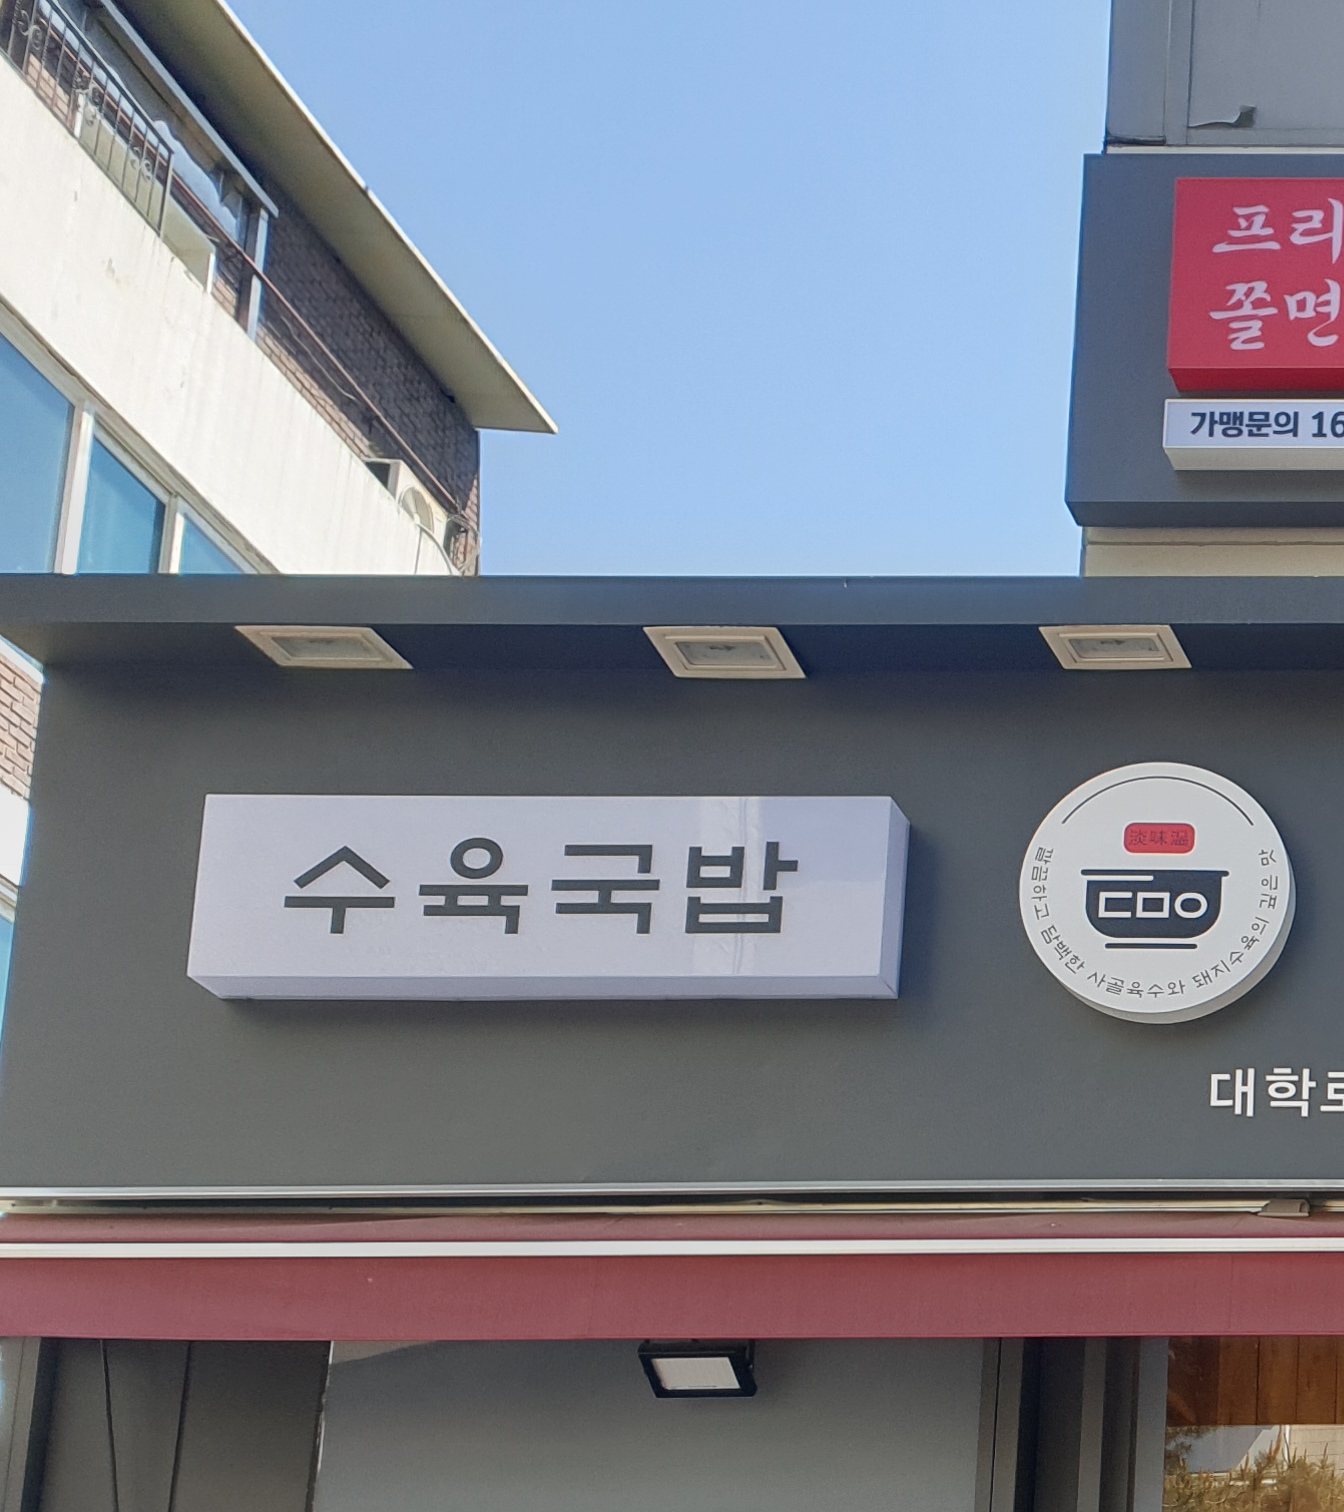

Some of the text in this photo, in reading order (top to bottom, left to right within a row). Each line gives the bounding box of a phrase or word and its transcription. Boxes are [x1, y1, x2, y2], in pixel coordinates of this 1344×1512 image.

[1190, 411, 1299, 438] 가맹문의
[284, 837, 799, 935] 수육국밥
[1041, 925, 1085, 974] 담백한
[1087, 971, 1186, 998] 사골육수와
